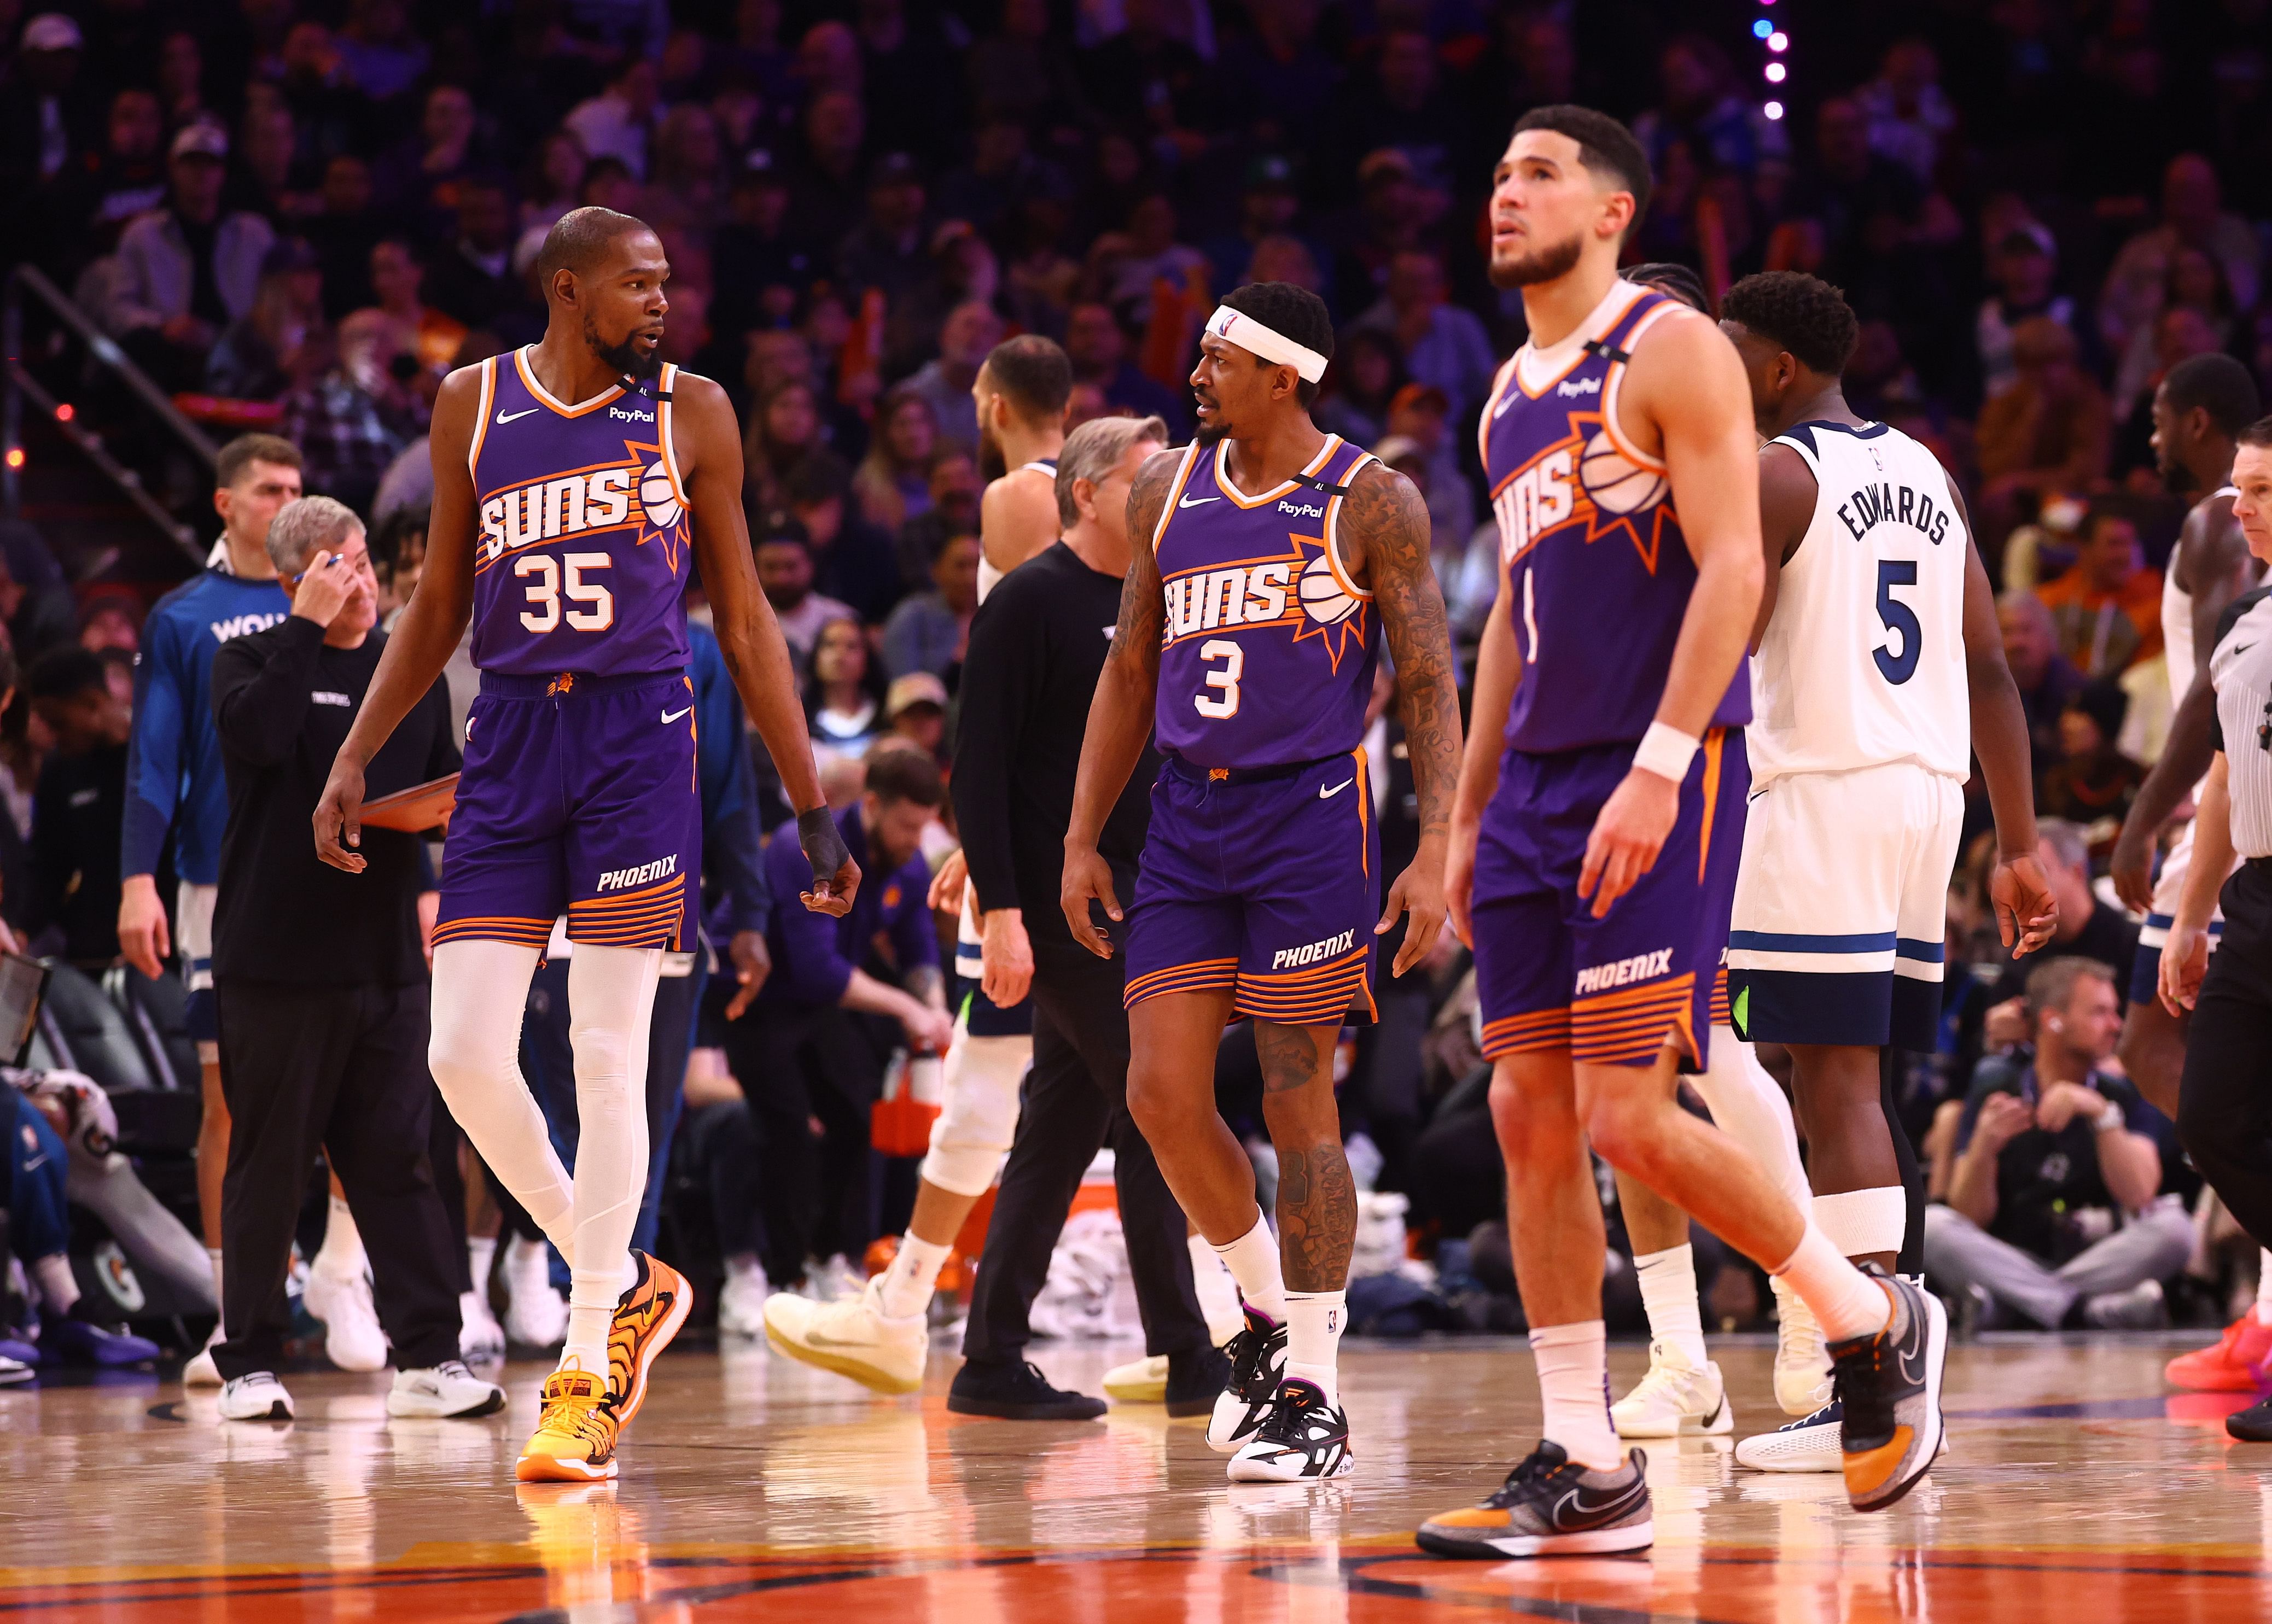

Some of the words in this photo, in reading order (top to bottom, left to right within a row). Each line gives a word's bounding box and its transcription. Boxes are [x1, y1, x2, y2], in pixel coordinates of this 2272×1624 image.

[639, 387, 648, 396] AL
[1557, 376, 1602, 400] PayPal
[609, 407, 654, 423] PayPal
[1278, 500, 1324, 518] PayPal
[1314, 482, 1325, 491] AL
[479, 469, 631, 561] SUNS
[1837, 483, 1949, 546] EDWARDS
[514, 552, 614, 633] 35
[1164, 563, 1291, 643] SUNS
[1523, 566, 1539, 664] 1
[210, 612, 287, 644] WO
[1872, 559, 1922, 685] 5
[1194, 640, 1245, 720] 3
[596, 854, 678, 892] PHOENIX
[1272, 928, 1354, 970] PHOENIX
[1575, 947, 1674, 995] PHOENIX
